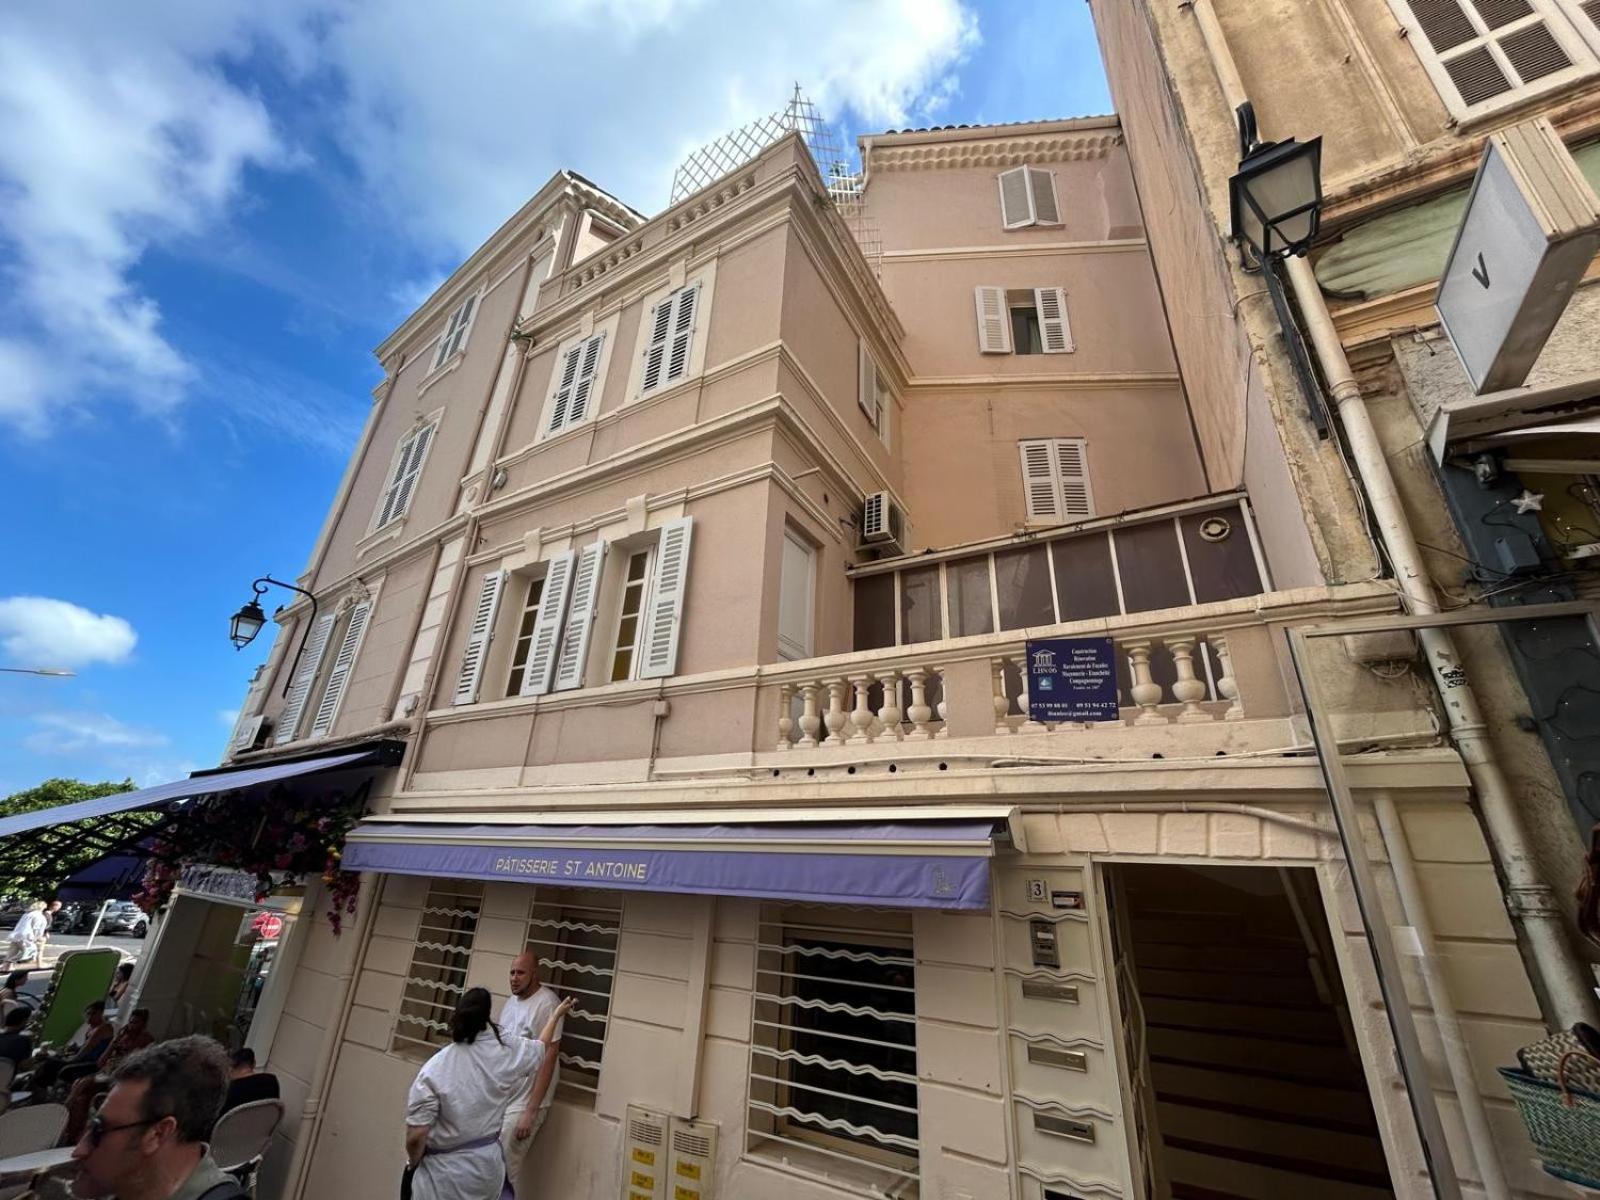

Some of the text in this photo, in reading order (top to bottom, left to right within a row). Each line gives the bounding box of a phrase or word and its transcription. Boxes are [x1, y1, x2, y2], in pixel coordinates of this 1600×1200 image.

[495, 856, 647, 879] PÂTISSERIE ST ANTOINE
[1034, 883, 1042, 896] 3
